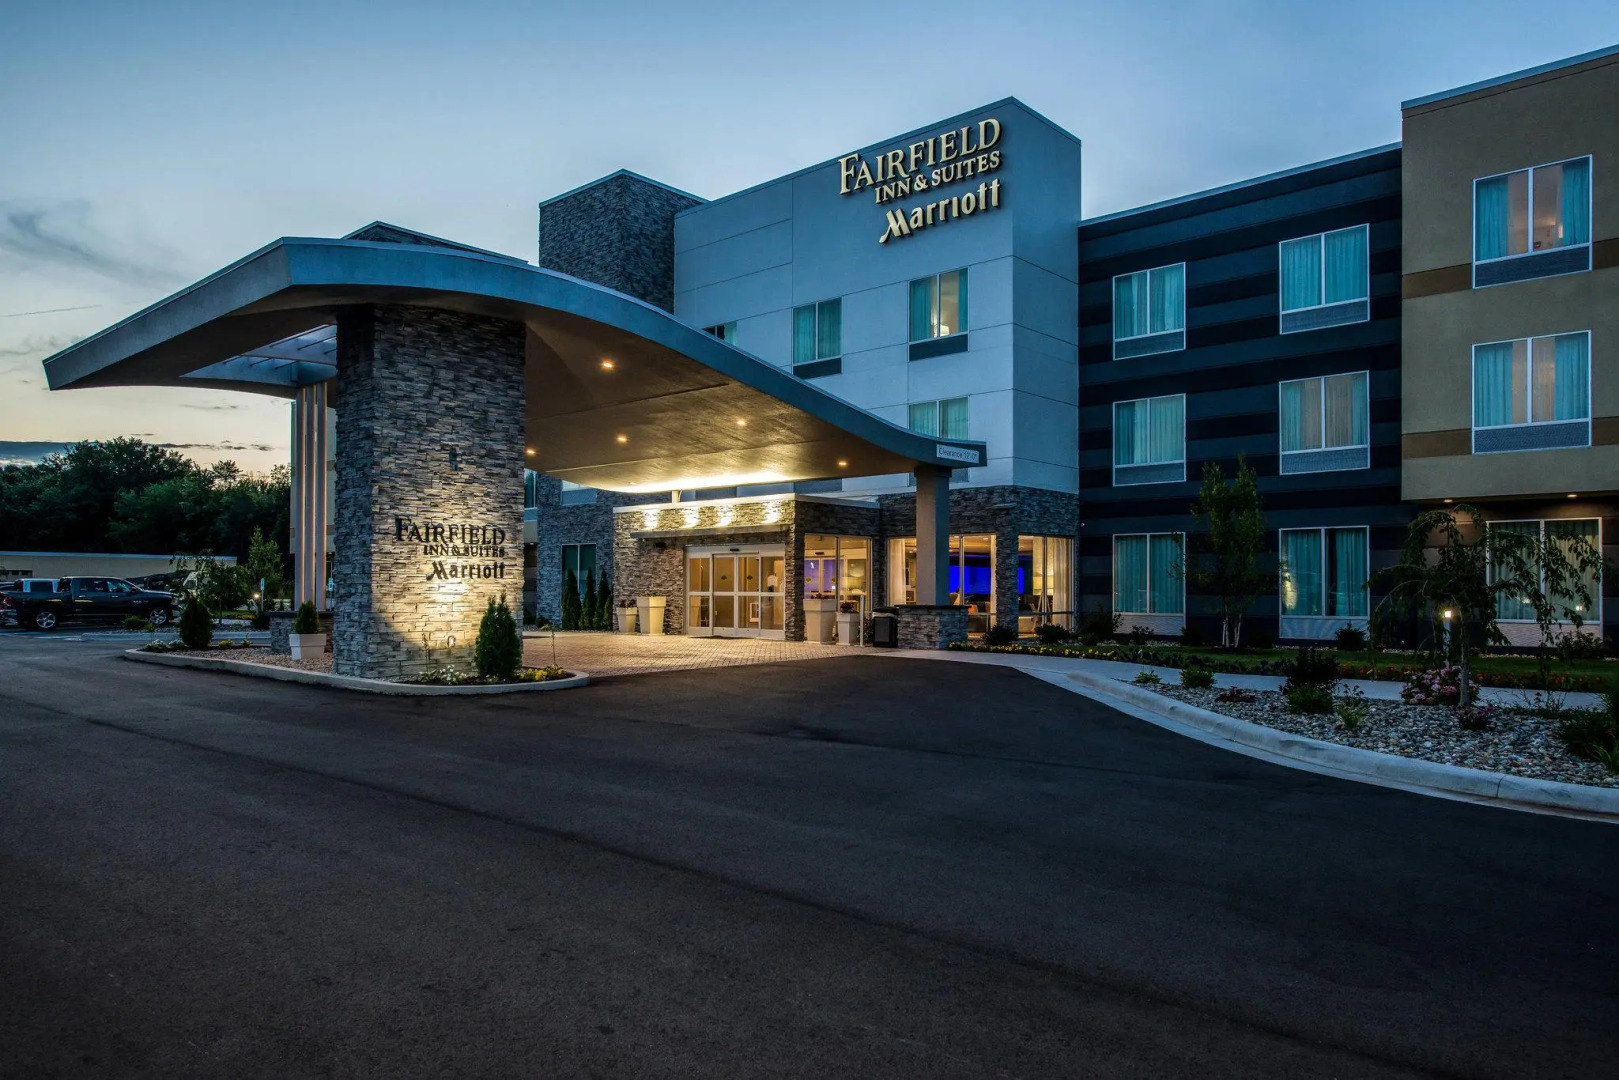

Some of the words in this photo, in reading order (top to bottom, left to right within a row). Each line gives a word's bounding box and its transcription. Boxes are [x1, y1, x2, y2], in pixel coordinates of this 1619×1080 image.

[838, 118, 1001, 195] FAIRFIELD
[874, 178, 911, 204] INN
[914, 174, 929, 192] &
[931, 150, 1000, 187] SUITES
[879, 178, 1000, 243] Marriott
[939, 447, 962, 459] Clearance
[394, 517, 506, 546] FAIRFIELD
[424, 544, 449, 556] INN
[452, 545, 462, 557] &
[464, 546, 505, 557] SUITES
[426, 561, 505, 580] Marriott
